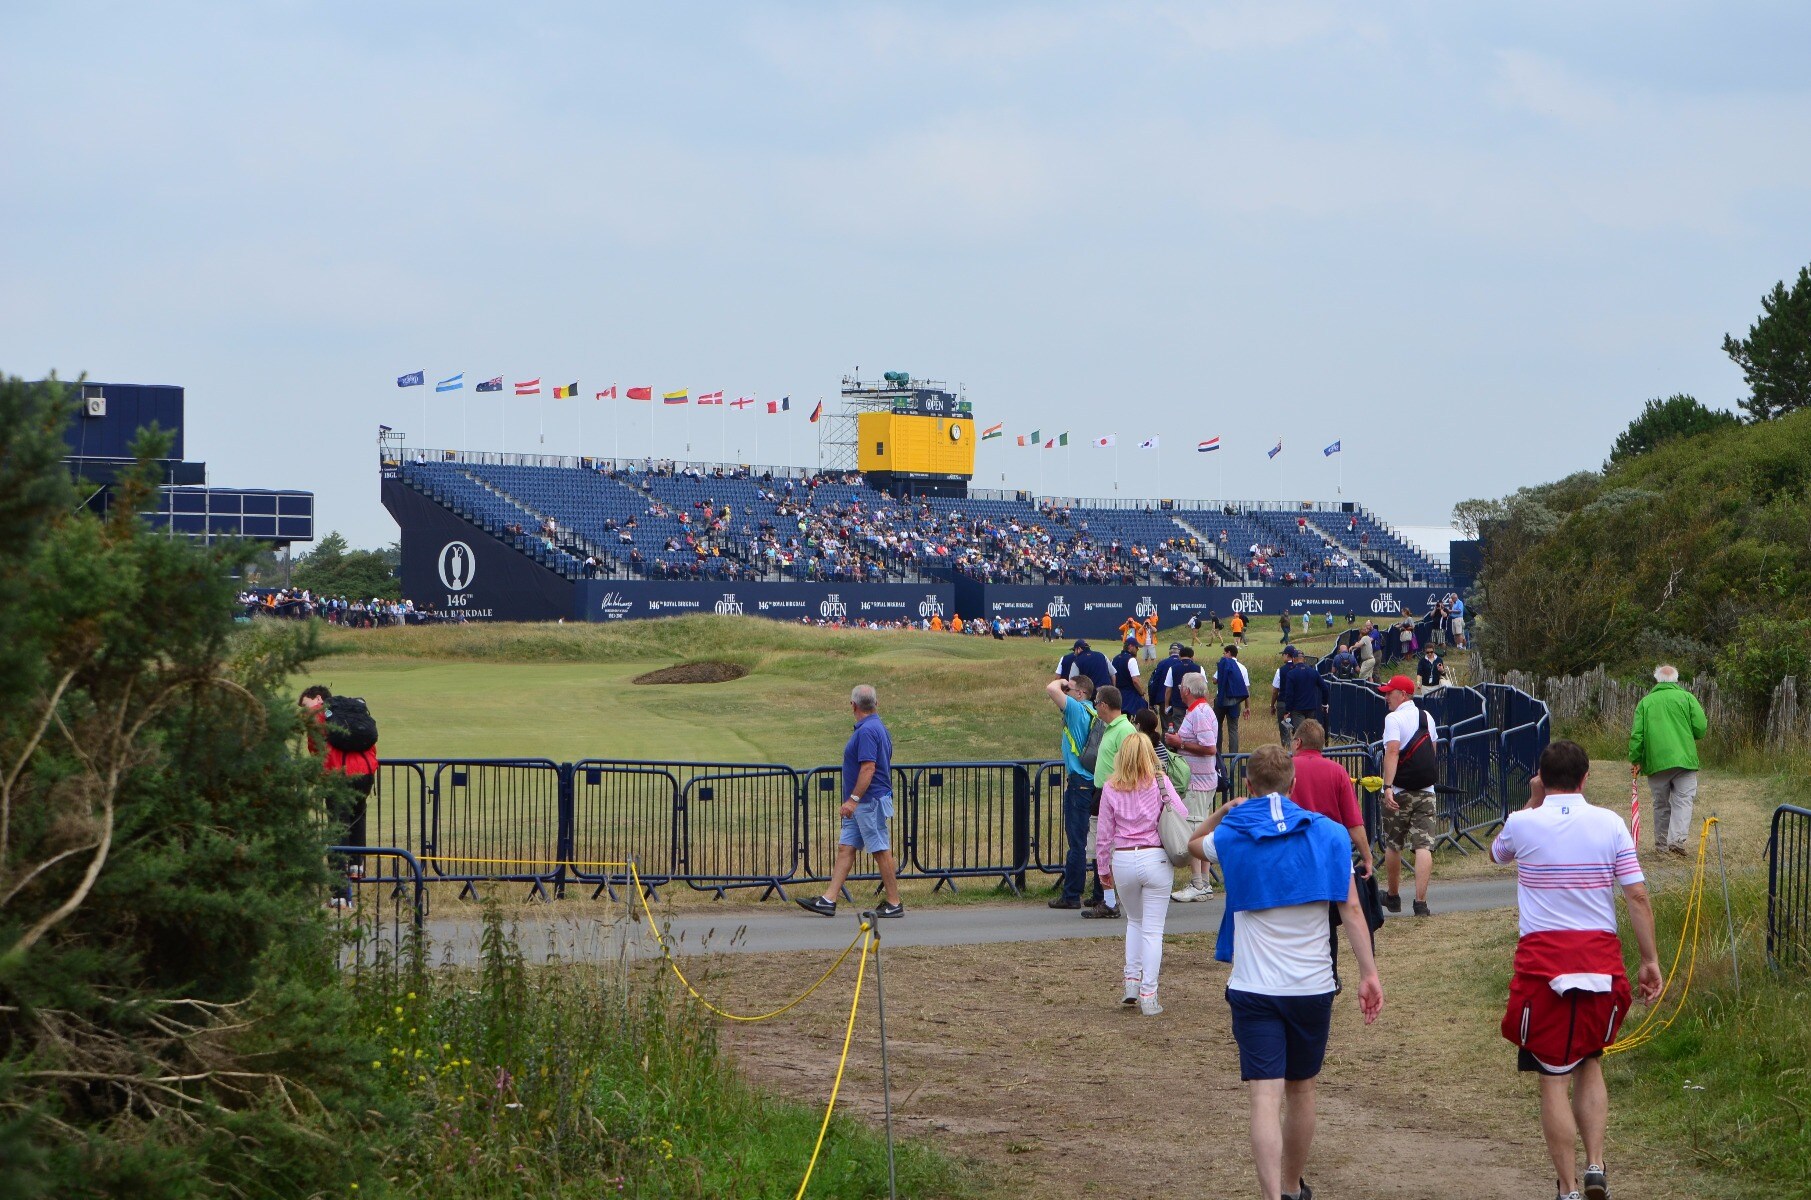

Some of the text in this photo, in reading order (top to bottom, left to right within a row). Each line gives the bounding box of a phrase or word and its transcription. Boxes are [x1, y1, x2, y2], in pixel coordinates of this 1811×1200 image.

[925, 398, 944, 411] OPEN
[723, 593, 736, 602] THE
[827, 593, 840, 602] THE
[1380, 592, 1392, 600] THE
[715, 600, 743, 616] OPEN
[820, 600, 847, 617] OPEN
[919, 601, 944, 617] OPEN
[1231, 598, 1263, 613] OPEN
[1370, 599, 1401, 613] OPEN
[1561, 806, 1570, 815] FJ
